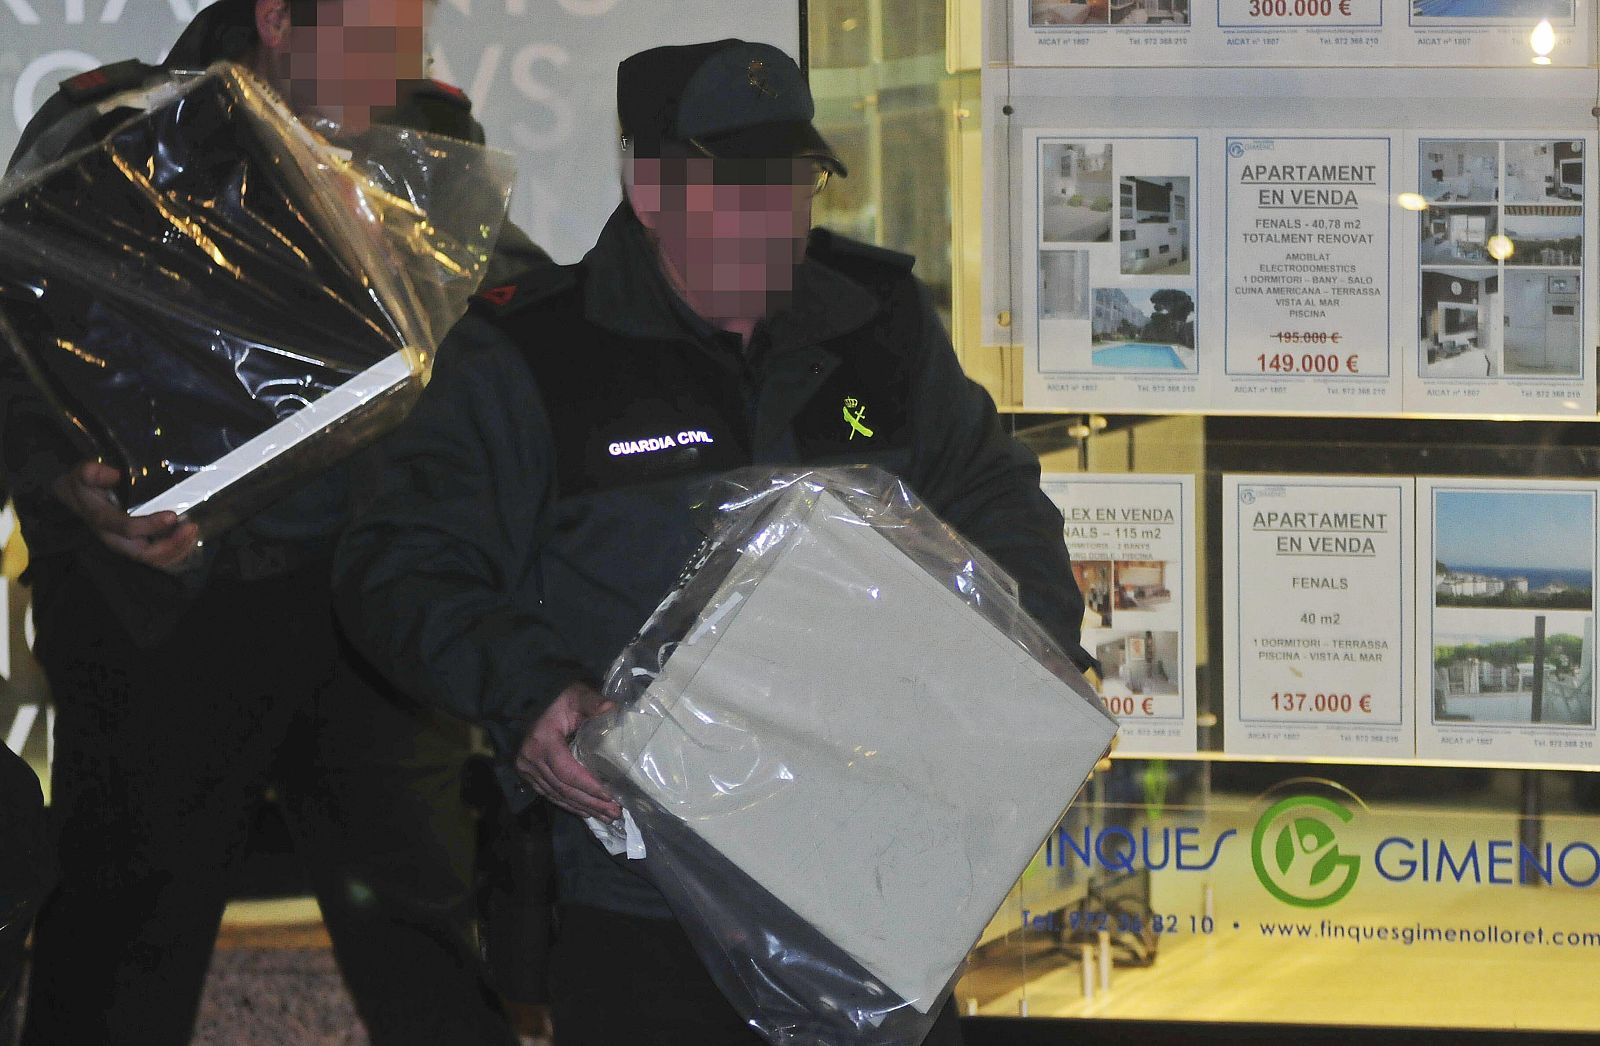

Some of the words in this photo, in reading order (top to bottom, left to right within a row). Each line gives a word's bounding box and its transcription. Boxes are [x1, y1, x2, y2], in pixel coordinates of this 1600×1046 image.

[1250, 0, 1332, 16] 300.000
[1338, 0, 1352, 16] €
[1240, 165, 1376, 181] APARTAMENT
[1258, 190, 1284, 205] EN
[1290, 190, 1358, 205] VENDA
[1255, 219, 1302, 230] FENALS
[1312, 219, 1341, 230] 40,78
[1344, 219, 1361, 230] m2
[1242, 233, 1313, 244] TOTALMENT
[1317, 233, 1374, 244] RENOVAT
[1260, 264, 1356, 272] ELECTRODOMESTICS
[1251, 276, 1302, 284] DORMITORI
[1312, 276, 1338, 284] BANY
[1348, 276, 1373, 284] SALO
[1235, 287, 1263, 295] CUINA
[1266, 287, 1320, 295] AMERICANA
[1332, 288, 1381, 296] TERRASSA
[1290, 310, 1326, 318] PISCINA
[1277, 332, 1327, 343] 195.000
[1330, 332, 1340, 343] €
[1258, 354, 1339, 372] 149.000
[1346, 354, 1358, 372] €
[608, 434, 676, 456] GUARDIA
[677, 430, 714, 446] CIVIL
[1063, 508, 1091, 521] LEX
[1096, 508, 1116, 521] EN
[1122, 508, 1174, 521] VENDA
[1252, 512, 1388, 529] APARTAMENT
[1064, 526, 1098, 538] NALS
[1116, 528, 1137, 540] 115
[1141, 528, 1161, 540] m2
[1276, 536, 1301, 553] EN
[1308, 536, 1376, 553] VENDA
[1292, 577, 1348, 590] FENALS
[1300, 614, 1316, 624] 40
[1320, 614, 1340, 624] m2
[1261, 639, 1320, 648] DORMITORI
[1332, 640, 1388, 649] TERRASSA
[1259, 652, 1300, 661] PISCINA
[1310, 653, 1340, 662] VISTA
[1344, 653, 1356, 662] AL
[1360, 653, 1382, 662] MAR
[1142, 697, 1154, 715] €
[1271, 692, 1352, 713] 137.000
[1360, 692, 1372, 713] €
[1046, 826, 1238, 874] INQUES
[1374, 837, 1600, 888] GIMENO
[1070, 910, 1108, 932] 972
[1116, 912, 1142, 933] 36
[1152, 914, 1178, 933] 82
[1190, 915, 1214, 934] 10
[1260, 921, 1600, 947] www.finquesgimenolloret.com
